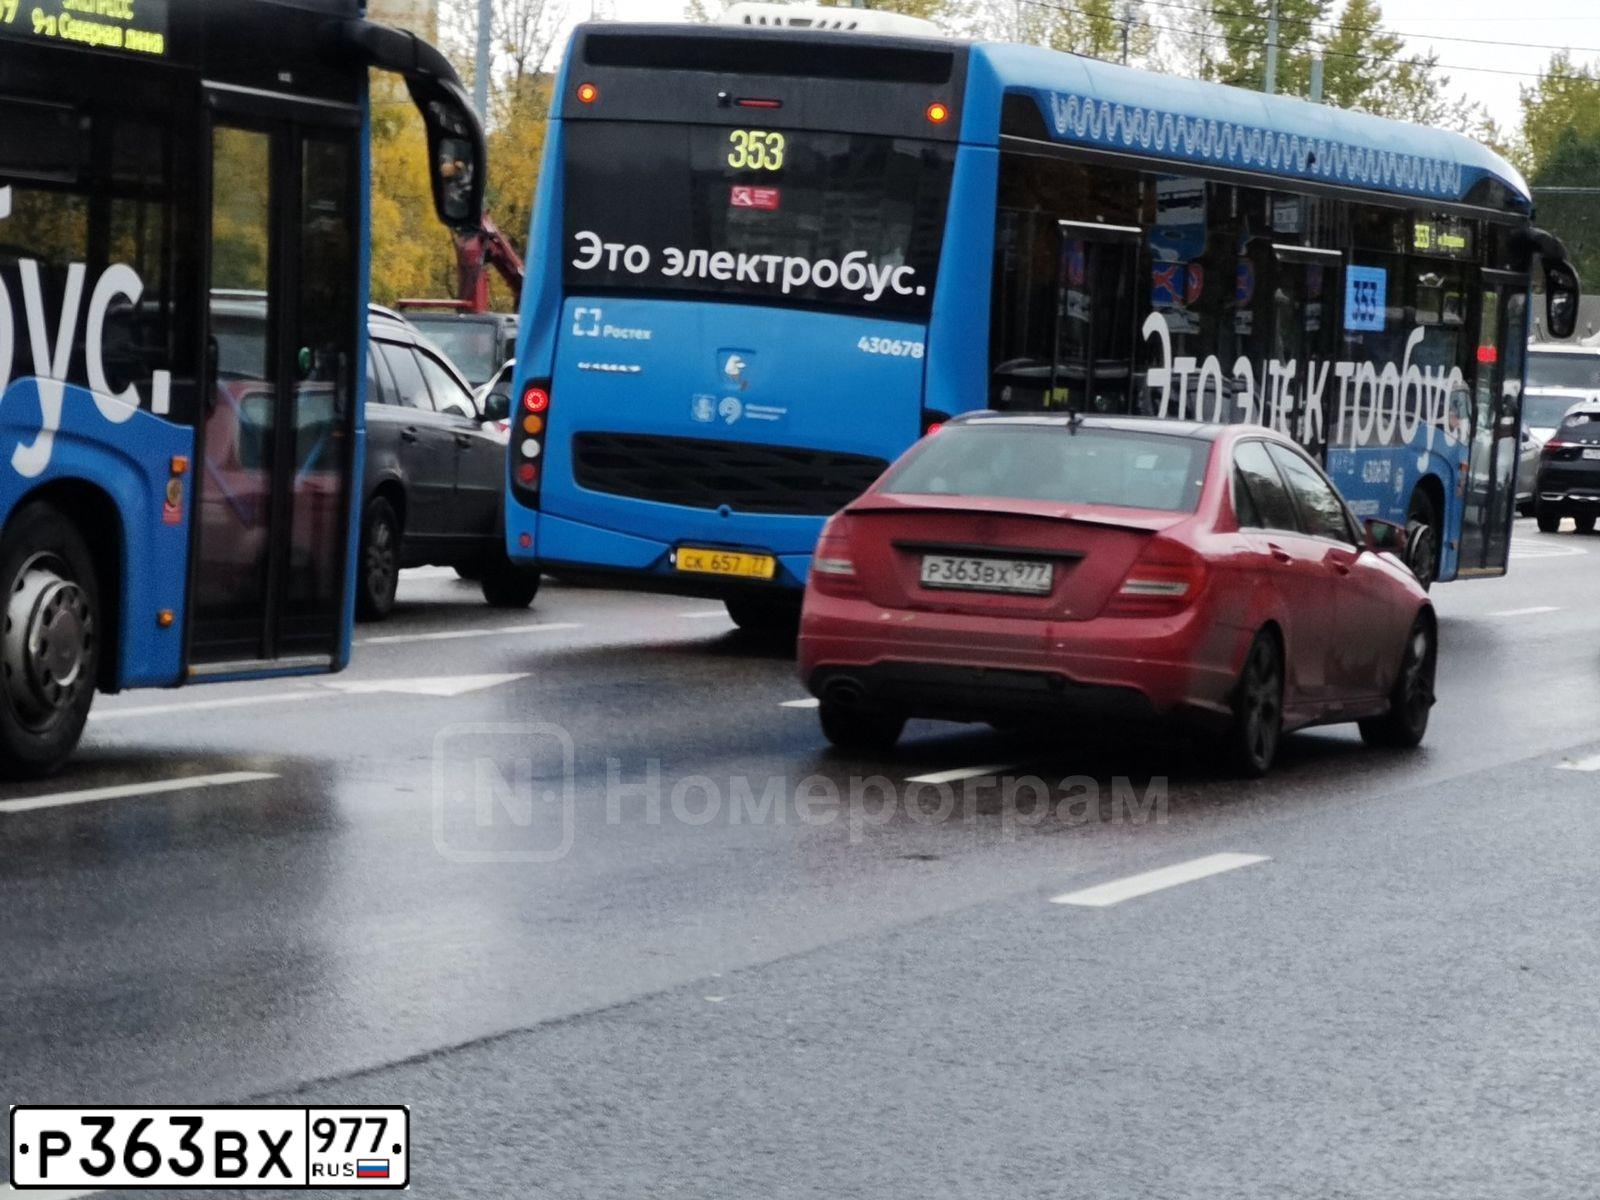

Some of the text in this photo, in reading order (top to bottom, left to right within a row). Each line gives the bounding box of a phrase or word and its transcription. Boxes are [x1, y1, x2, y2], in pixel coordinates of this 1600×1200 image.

[727, 129, 785, 171] 353
[572, 230, 926, 302] Это электробус.
[0, 184, 171, 478] ус.
[603, 325, 651, 341] Ростех
[857, 335, 925, 359] 430678
